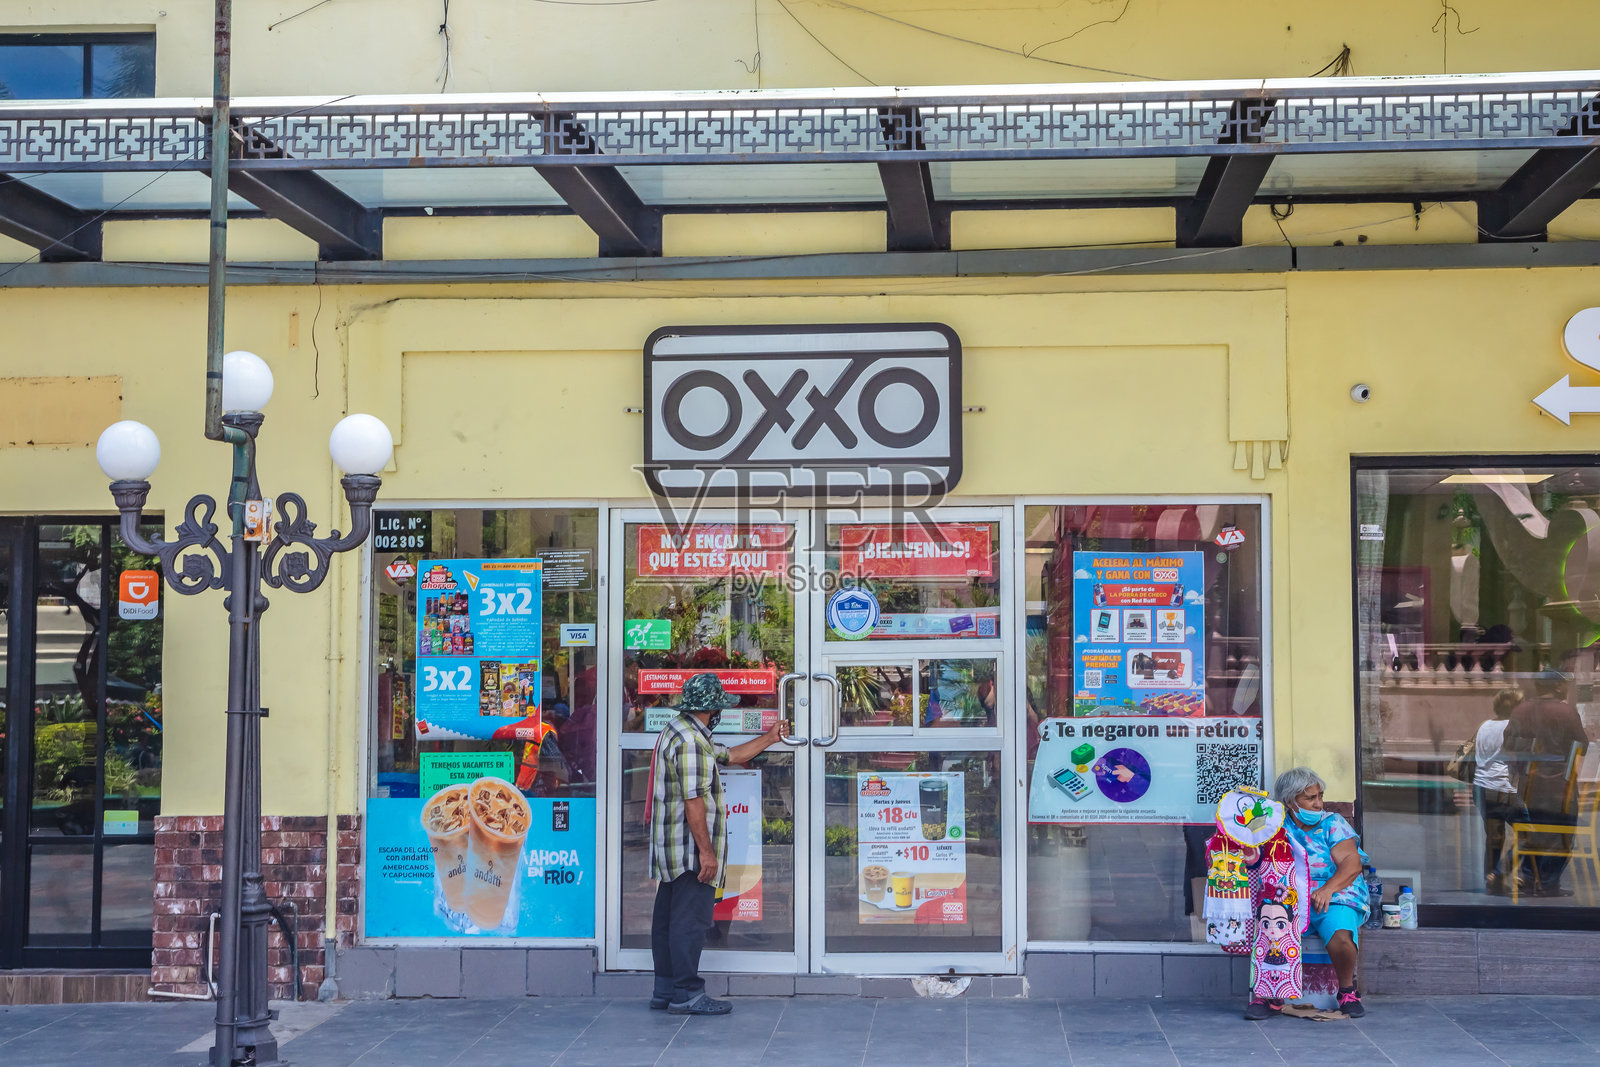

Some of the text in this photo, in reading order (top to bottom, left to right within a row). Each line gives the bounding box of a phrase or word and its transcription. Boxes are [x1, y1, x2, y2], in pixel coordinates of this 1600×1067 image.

[661, 357, 941, 463] OXXO
[380, 518, 404, 530] LIC.
[375, 535, 425, 549] 002305
[661, 534, 762, 549] NOS ENCANTA
[859, 541, 970, 563] ¡BIENVENIDO!
[649, 550, 768, 571] QUE ESTÉS AQUÍ
[1092, 556, 1184, 568] ACELERA AL MÁXIMO
[1096, 570, 1177, 580] Y GANA CON OXXO
[421, 582, 458, 590] ahorrar
[480, 587, 532, 616] 3x2
[569, 632, 587, 640] VISA
[423, 666, 472, 692] 3x2
[719, 677, 739, 685] nción
[749, 677, 767, 685] horas
[1055, 722, 1075, 737] Te
[1082, 724, 1159, 741] negaron
[1166, 724, 1194, 737] un
[1196, 721, 1249, 737] retiro
[431, 761, 460, 770] TENEMOS
[462, 761, 494, 769] VACANTES
[467, 771, 484, 779] ZONA
[732, 803, 749, 814] c/u
[878, 807, 917, 823] $18 c/u
[401, 853, 429, 861] andatti
[904, 846, 929, 860] $10
[448, 863, 467, 879] anda
[528, 866, 543, 877] EN
[474, 868, 502, 888] andatti
[943, 903, 963, 913] OXXO
